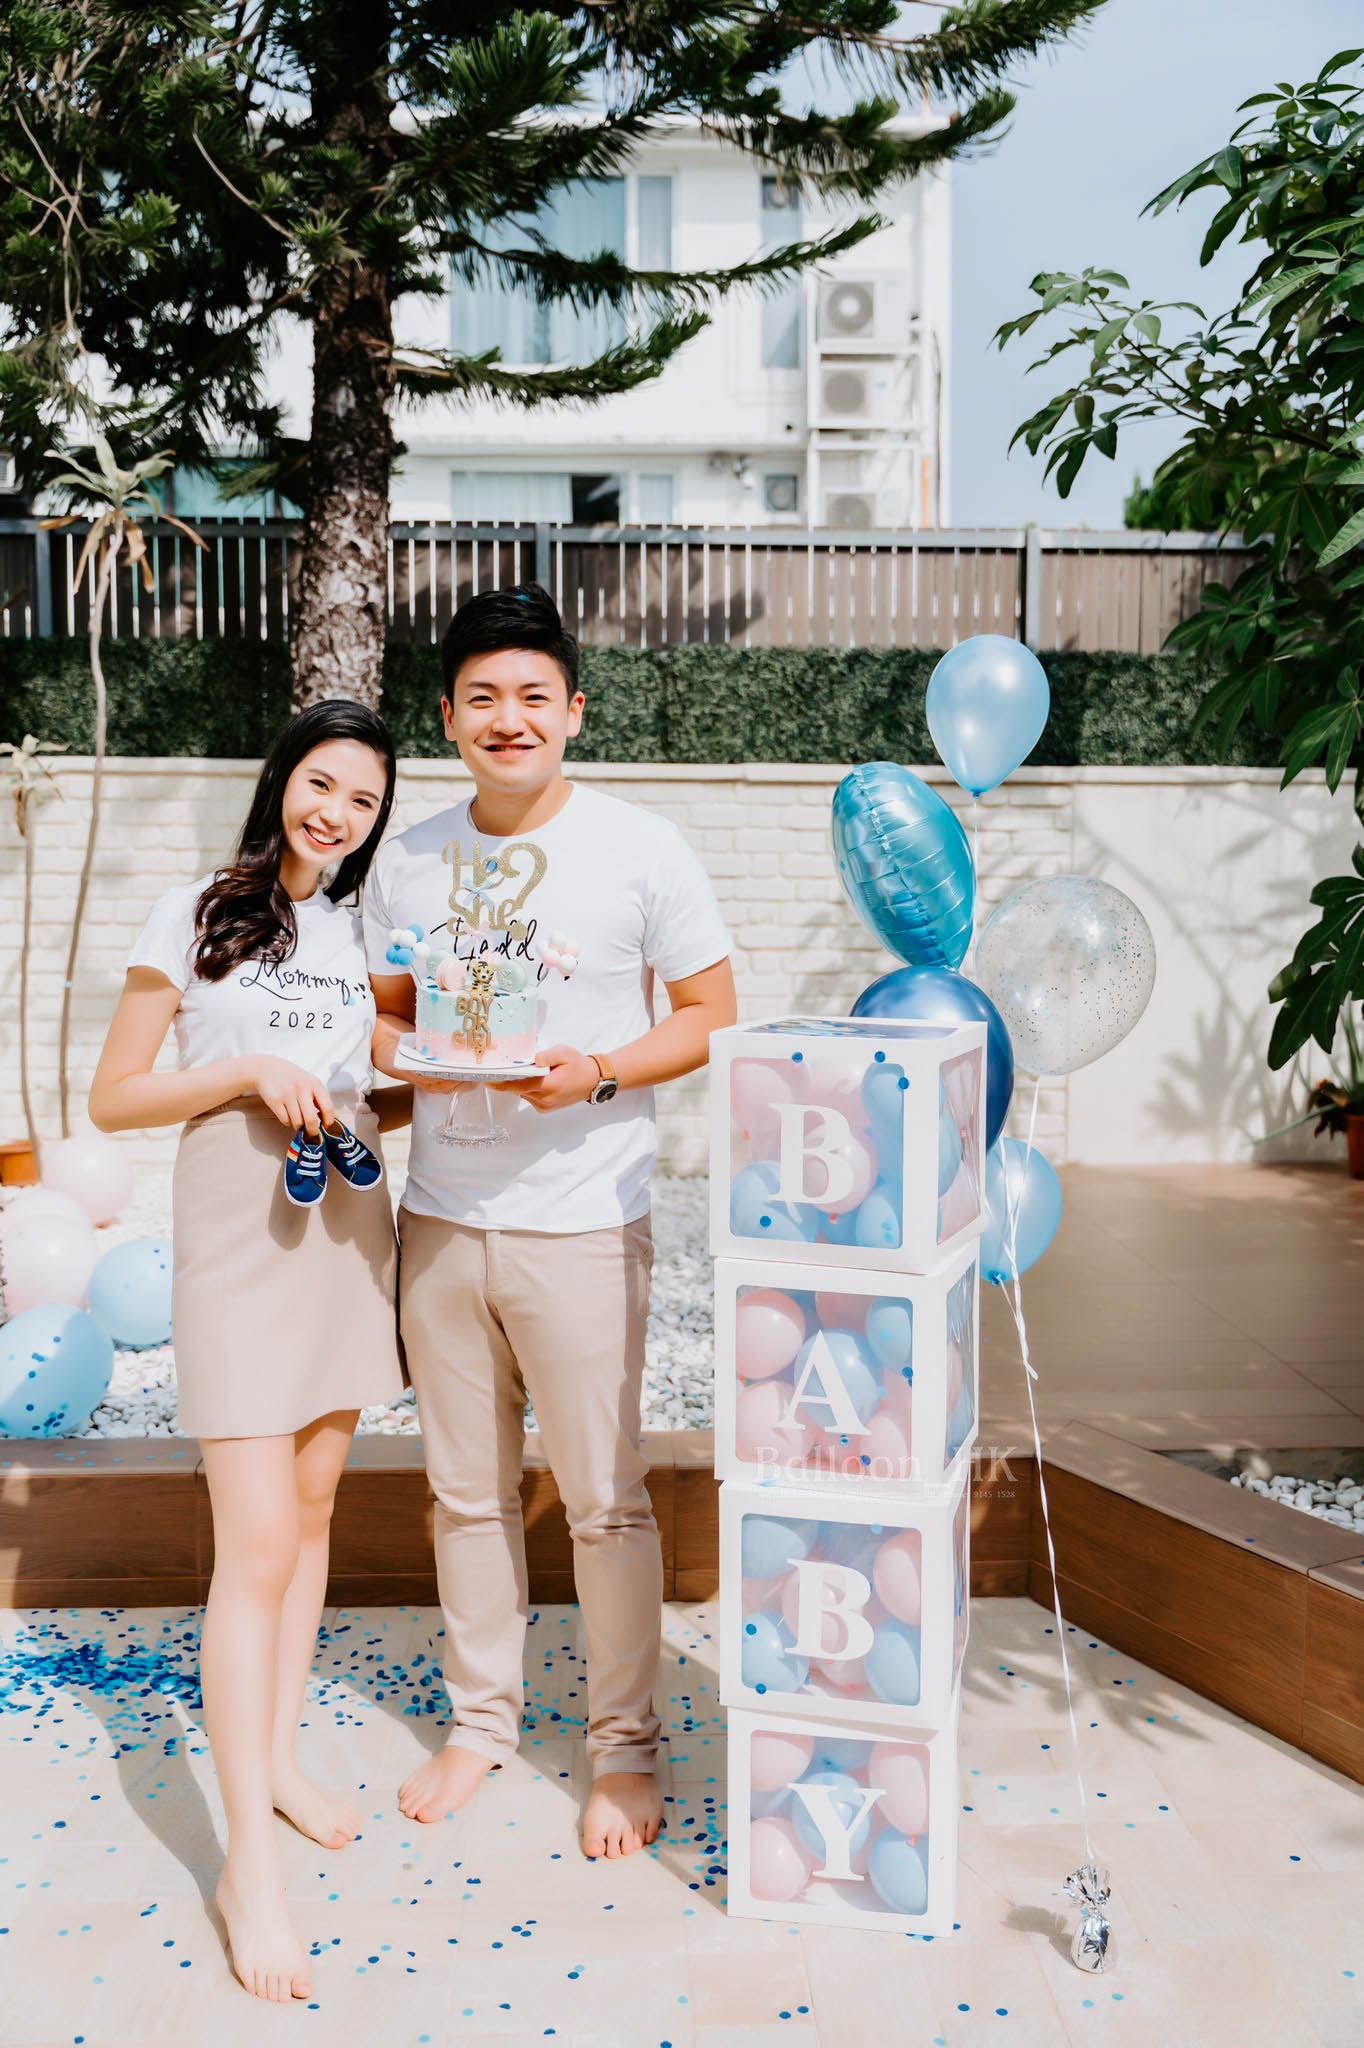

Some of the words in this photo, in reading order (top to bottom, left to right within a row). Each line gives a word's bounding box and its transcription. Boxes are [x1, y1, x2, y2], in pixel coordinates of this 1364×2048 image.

[240, 953, 351, 1006] Mommy
[269, 1010, 333, 1029] 2022
[455, 994, 496, 1022] BOY
